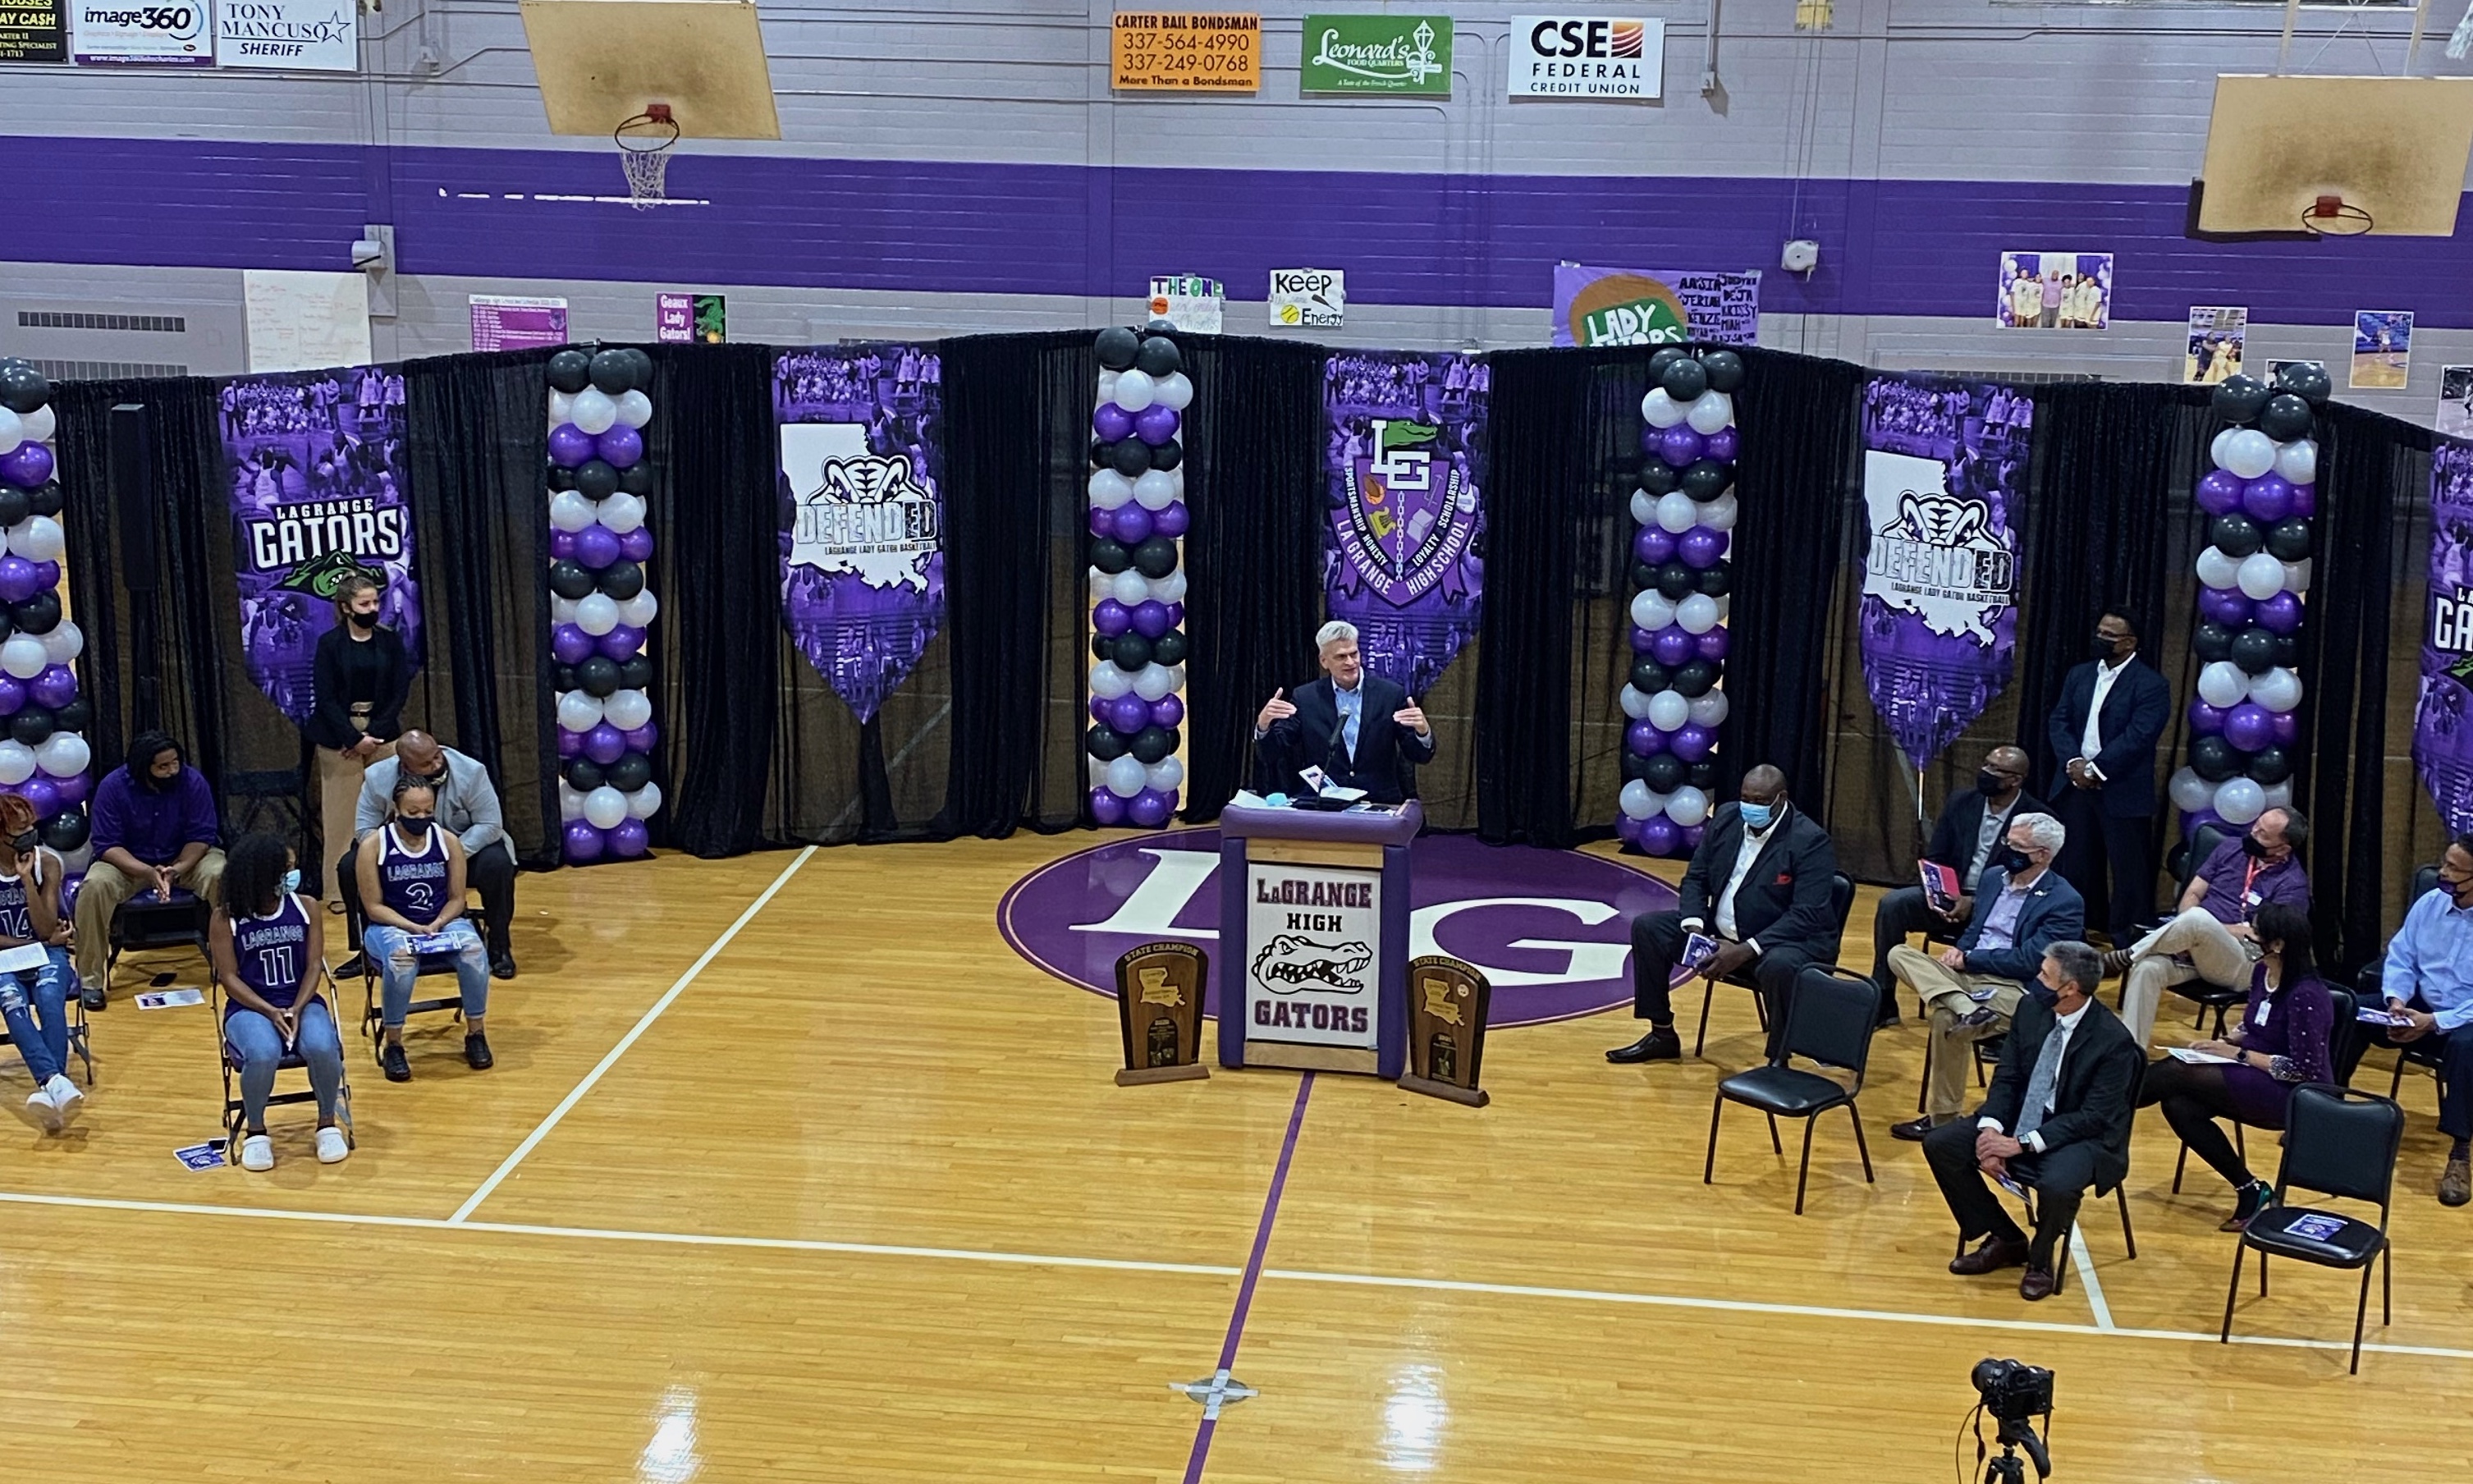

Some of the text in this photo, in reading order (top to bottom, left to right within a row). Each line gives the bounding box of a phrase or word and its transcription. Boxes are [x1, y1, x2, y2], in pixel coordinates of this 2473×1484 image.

[227, 3, 286, 20] TONY
[222, 21, 328, 39] MANCUSO
[1115, 15, 1257, 30] CARTER BAIL BONDSMAN
[1124, 32, 1249, 51] 337-564-4990
[1312, 29, 1411, 67] Leonard's
[1531, 21, 1609, 57] CSE
[240, 43, 304, 57] SHERIFF
[1124, 53, 1248, 71] 337-249-0768
[1532, 63, 1640, 78] FEDERAL
[1120, 75, 1148, 85] More
[1152, 75, 1178, 85] Than
[1193, 76, 1253, 86] Bondsman
[1531, 82, 1639, 94] CREDIT UNION
[1152, 277, 1222, 297] THE ONE
[665, 311, 685, 327] Lady
[1587, 304, 1656, 343] LADY
[276, 498, 373, 520] LAGRANGE
[1344, 467, 1389, 566] SPORTSMANSHIP HONESTY
[1412, 469, 1460, 567] LOYALTY SCHOLARSHIP
[796, 500, 937, 544] DEFENDED
[253, 509, 400, 568] GATORS
[859, 545, 875, 554] LADY
[900, 542, 937, 552] BASKETBALL
[1347, 541, 1394, 594] GRANGE
[1406, 521, 1469, 596] HIGH SCHOOL
[1869, 534, 2013, 592] DEFENDED
[1924, 588, 1940, 598] LADY
[1967, 593, 2009, 604] BASKETBALL
[387, 862, 446, 882] LAGRANGE
[405, 882, 433, 910] 2
[1287, 913, 1342, 932] HIGH
[241, 925, 304, 950] LAGRANGE
[1124, 943, 1199, 962] STATE CHAMPION
[1413, 956, 1438, 967] STATE
[260, 946, 295, 986] 11
[1255, 1000, 1369, 1033] GATORS
